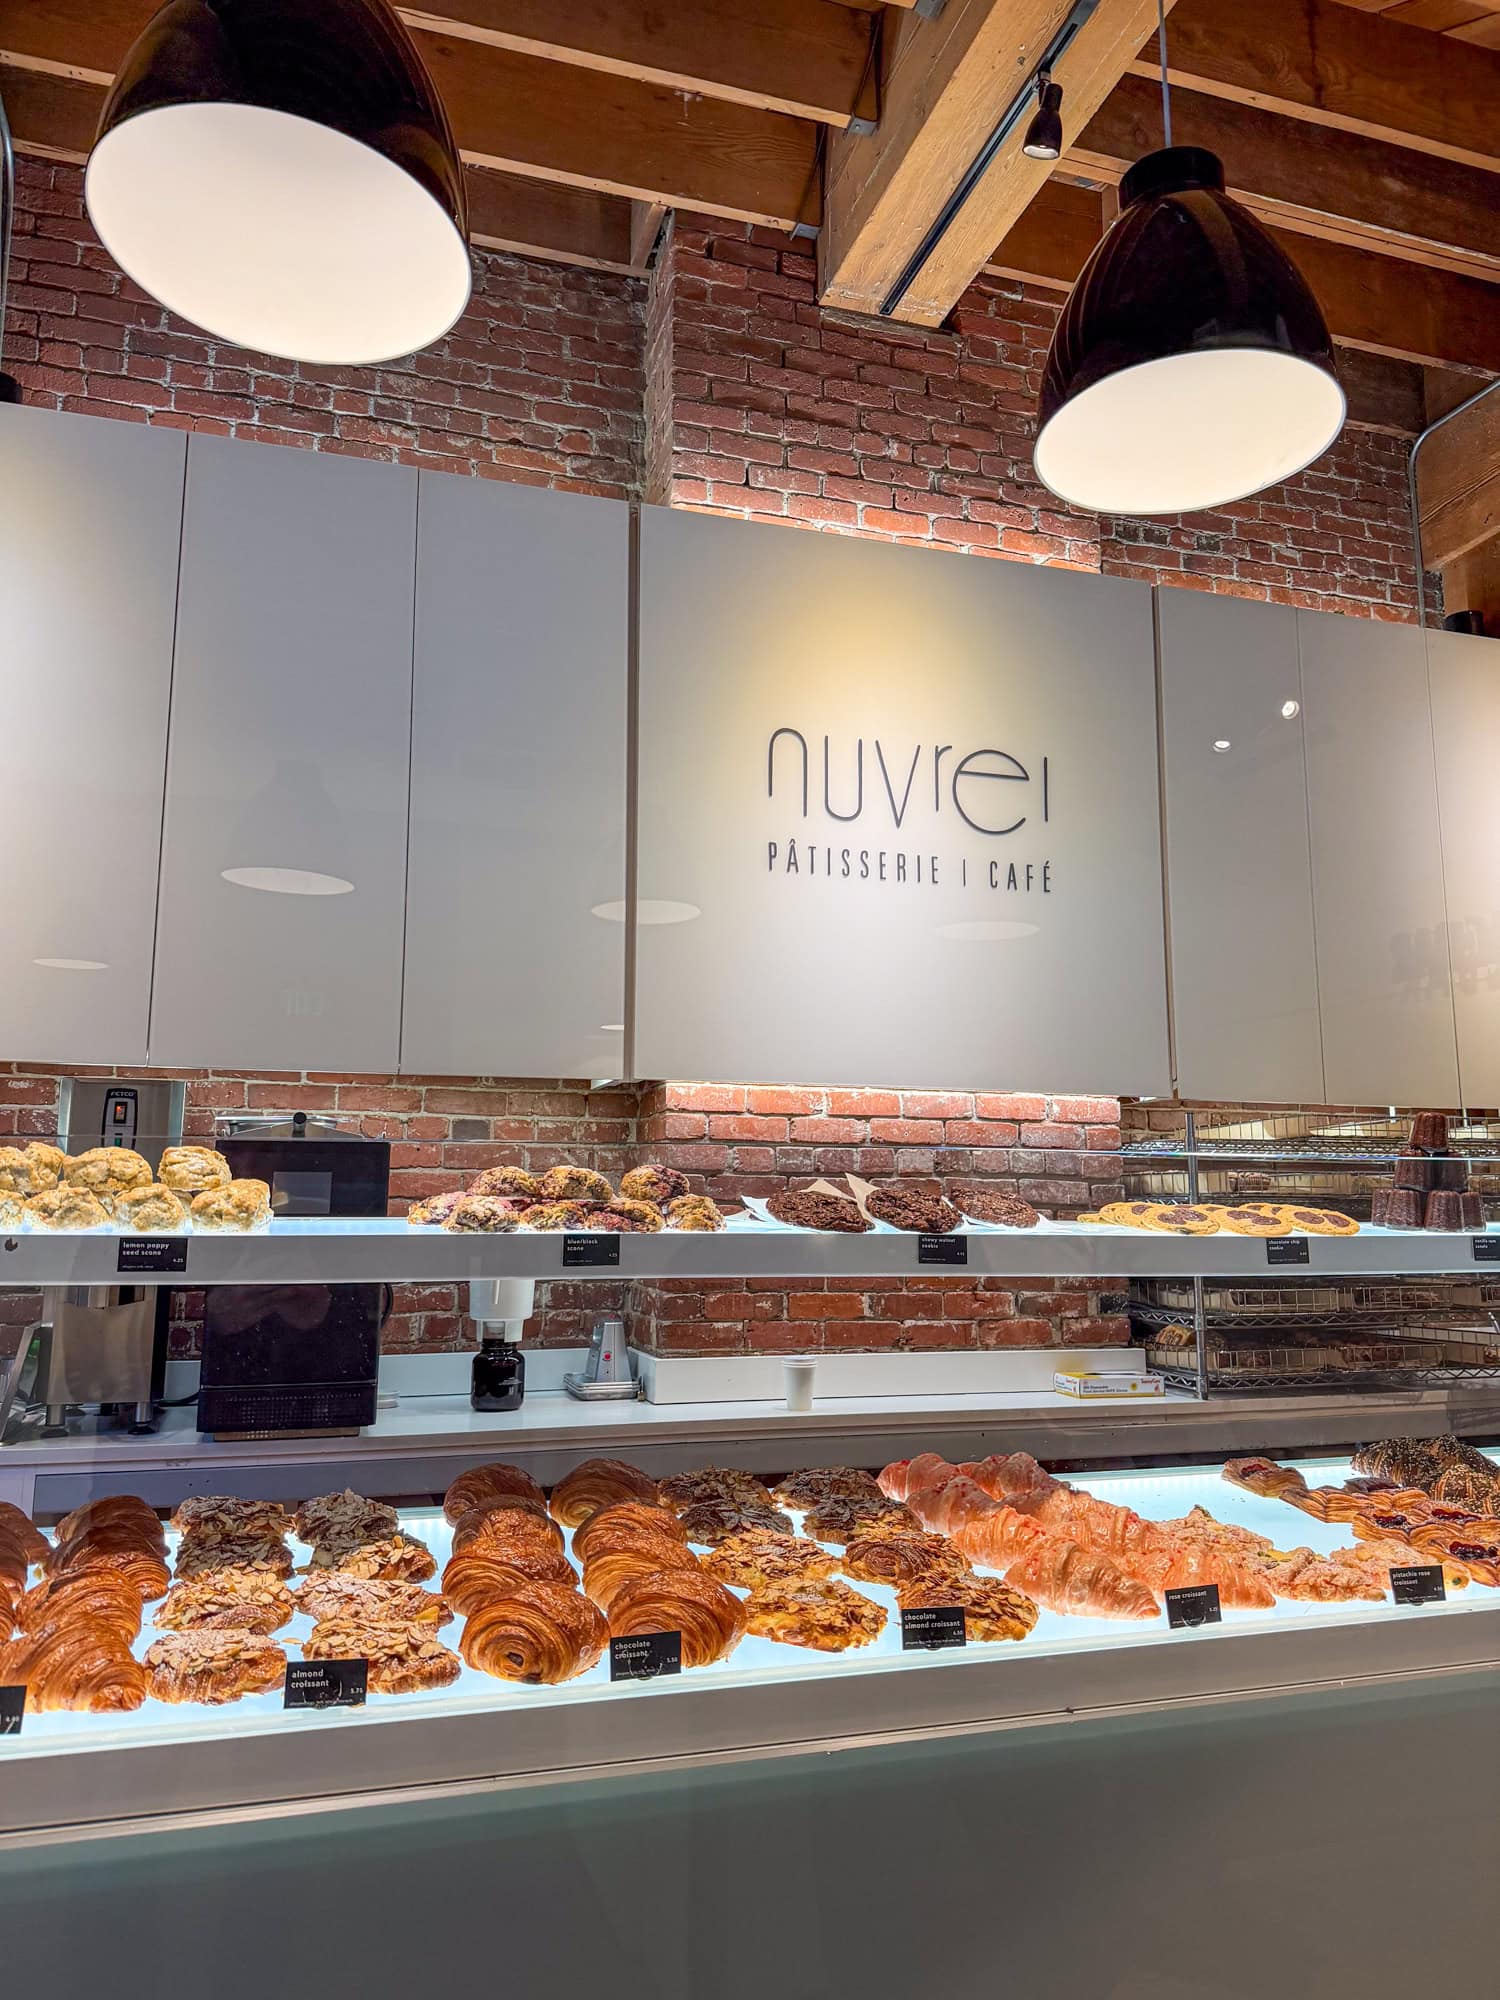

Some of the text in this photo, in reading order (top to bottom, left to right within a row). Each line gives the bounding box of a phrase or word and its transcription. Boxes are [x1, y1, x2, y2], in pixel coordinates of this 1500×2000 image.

[768, 727, 1050, 836] nuvrei
[768, 838, 940, 885] PÂTISSERIE
[989, 860, 1052, 893] CAFÉ
[123, 1241, 145, 1249] lemon
[904, 1612, 937, 1621] chocolate
[904, 1620, 961, 1630] almond croissant
[614, 1640, 651, 1650] chocolate
[615, 1650, 649, 1660] croissant
[291, 1668, 324, 1679] almond
[290, 1679, 329, 1689] croissant
